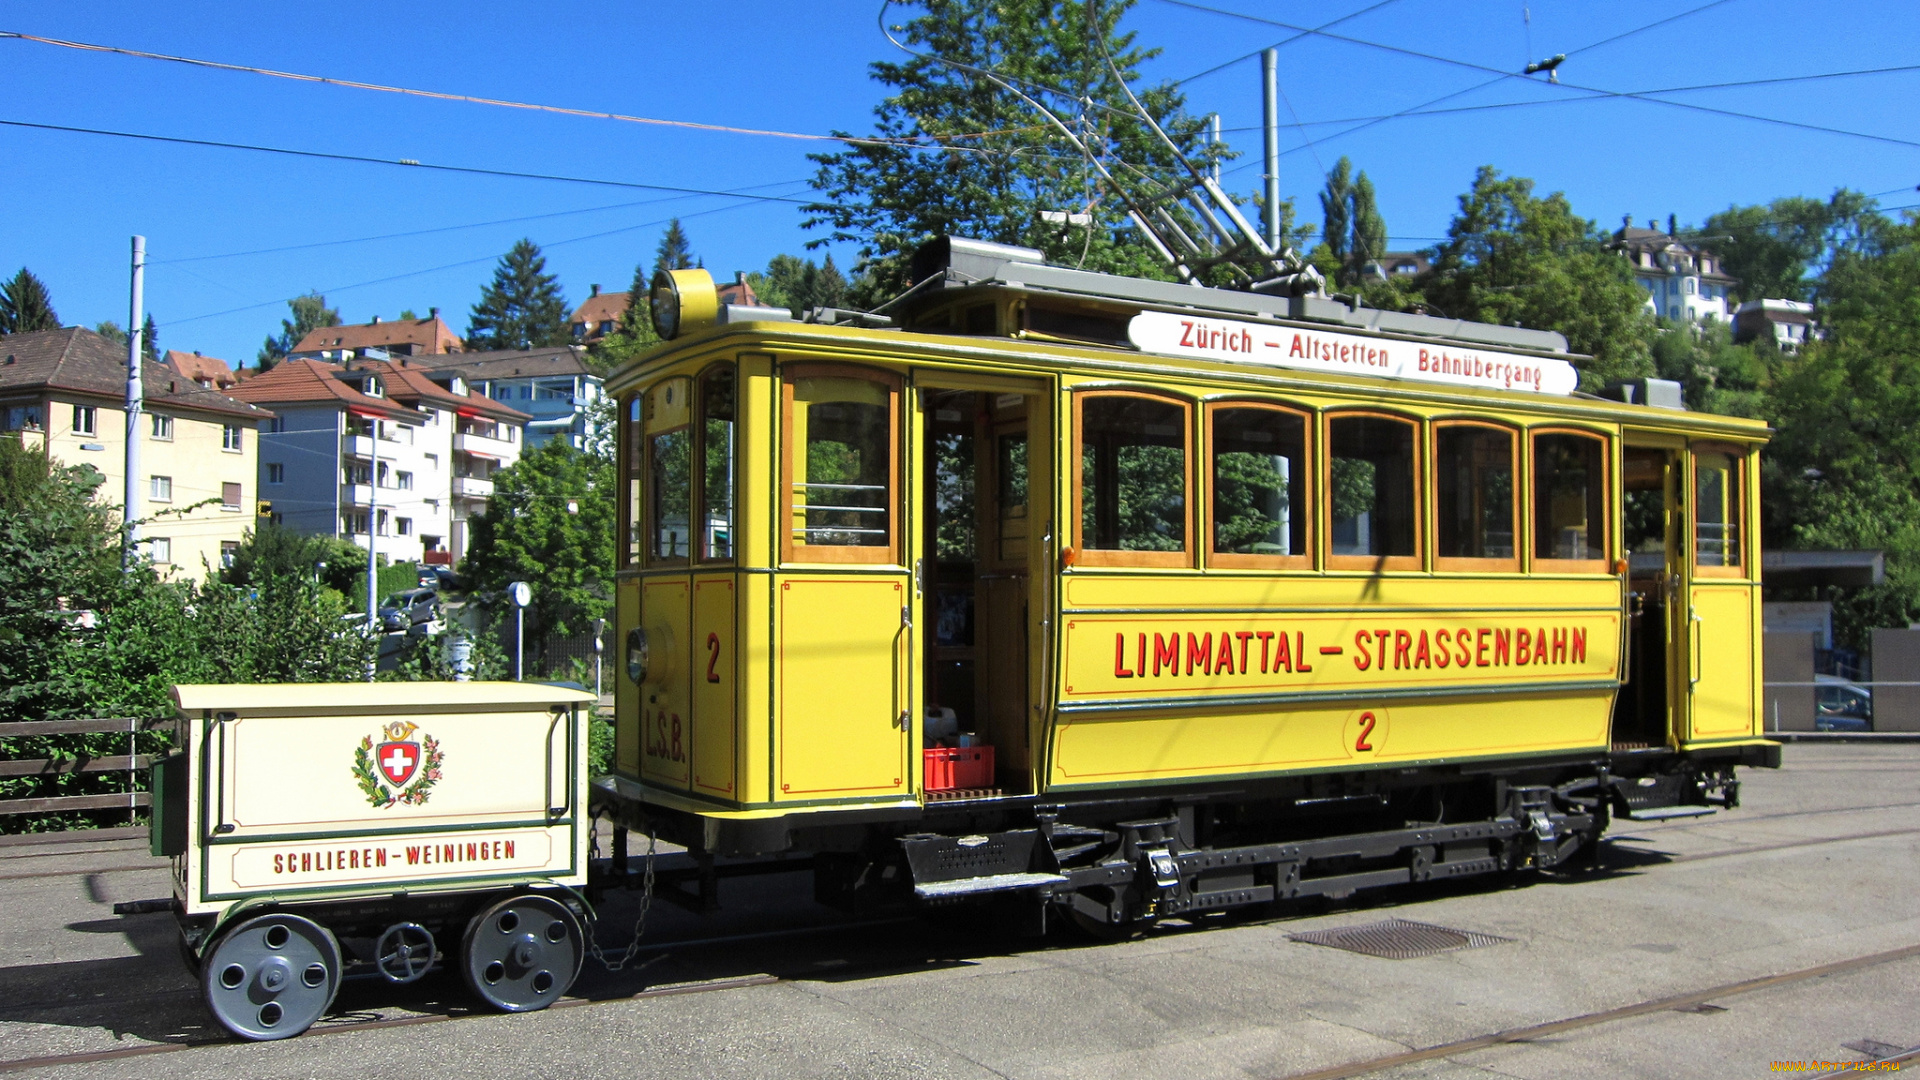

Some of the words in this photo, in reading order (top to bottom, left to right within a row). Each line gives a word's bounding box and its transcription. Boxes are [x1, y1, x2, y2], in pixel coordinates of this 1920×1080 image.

[1179, 321, 1252, 353] Zürich
[1289, 333, 1390, 368] Altstetten
[1418, 348, 1543, 391] Bahnübergang
[707, 631, 720, 684] 2
[645, 709, 685, 763] L.S.B.
[1355, 711, 1376, 751] 2
